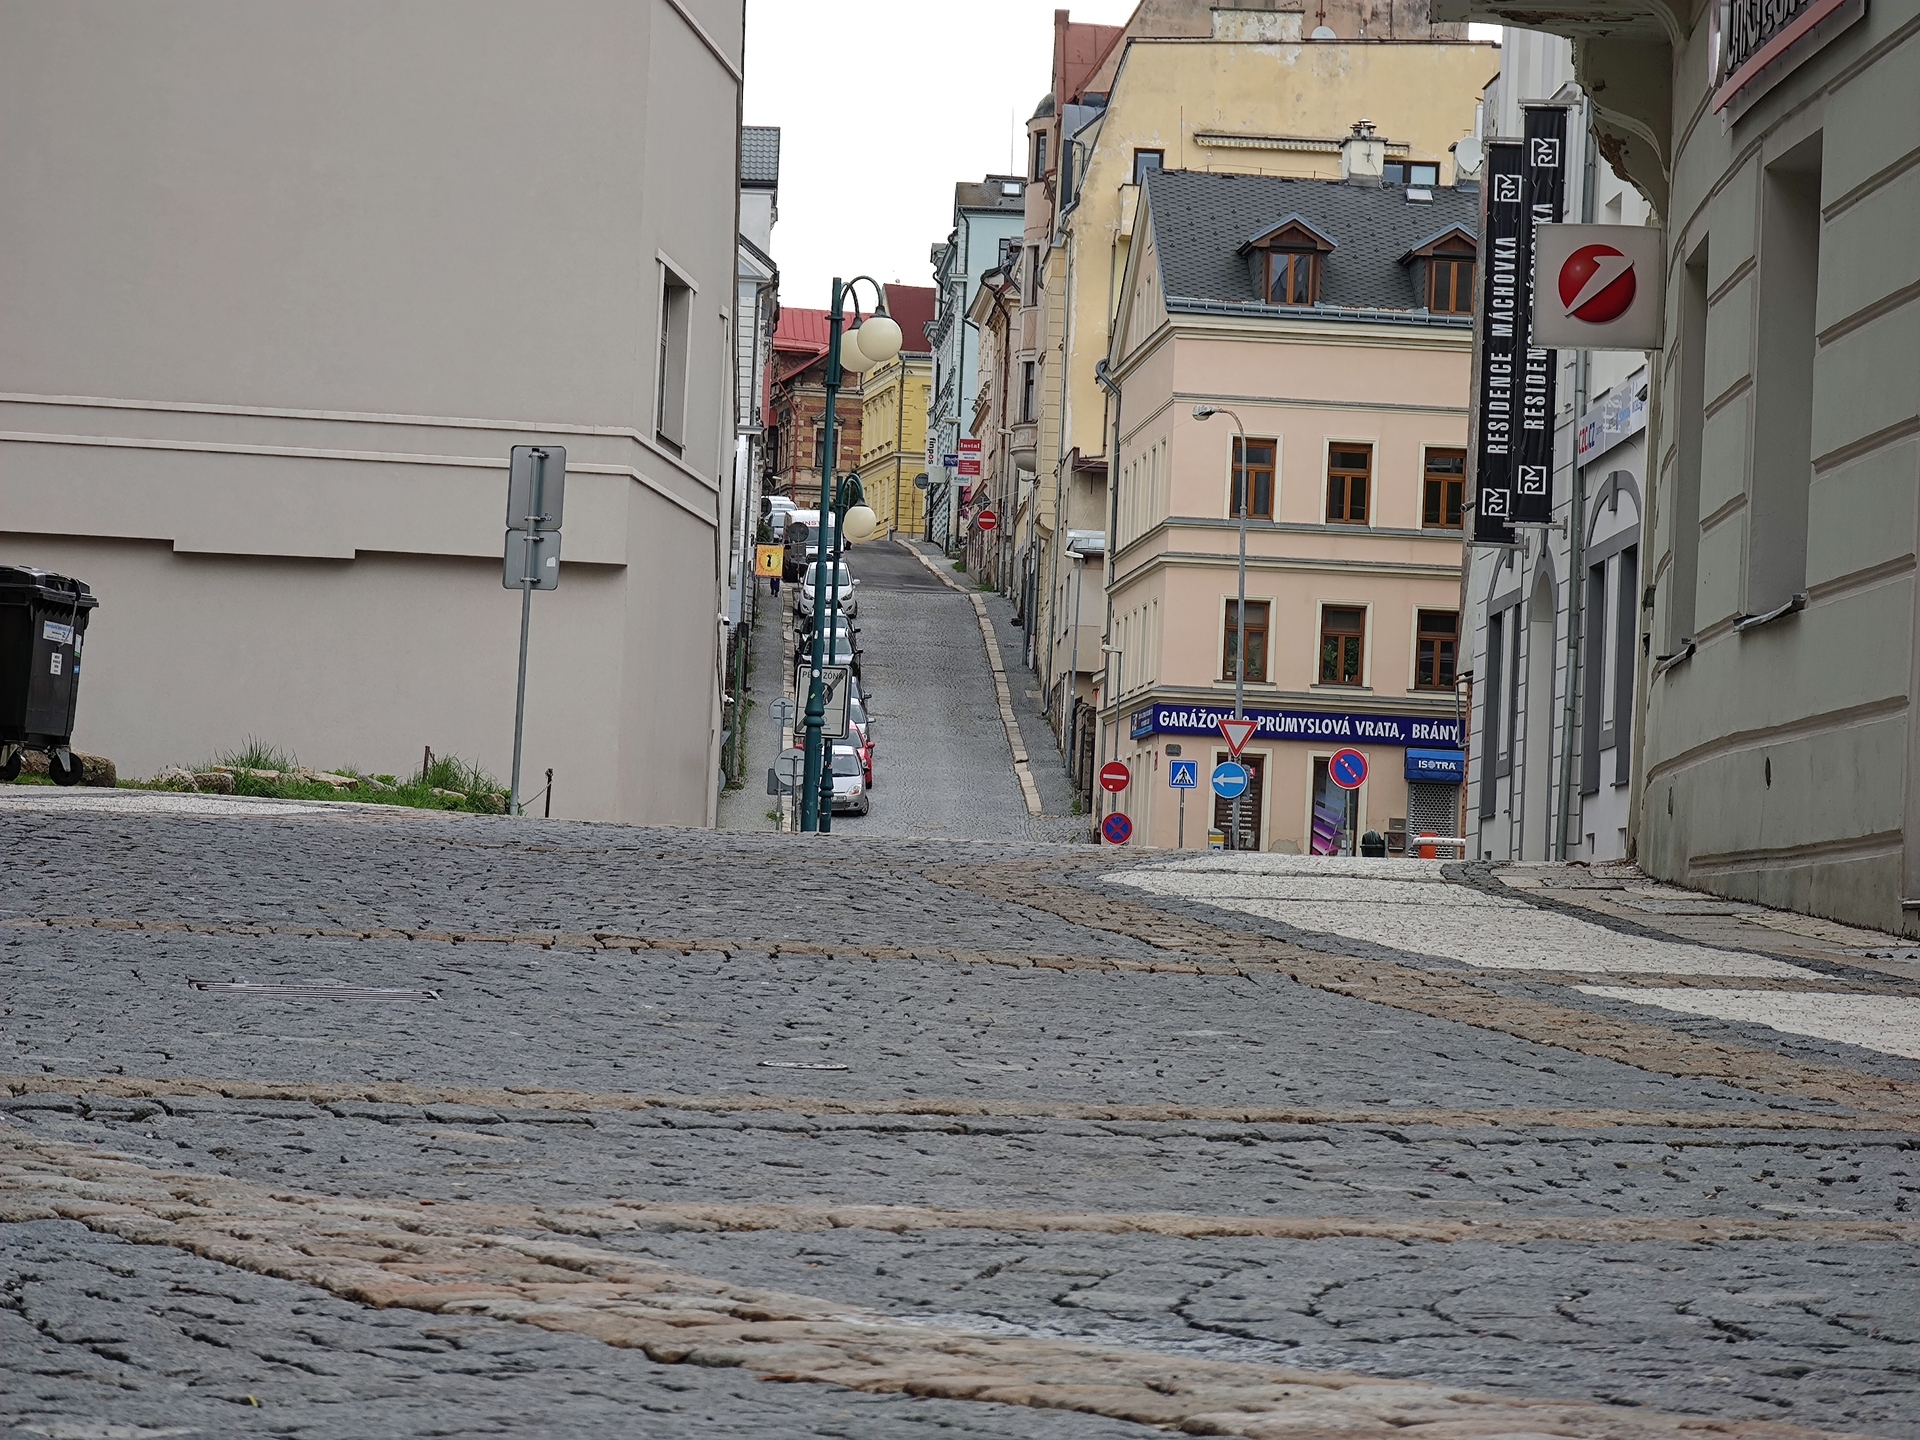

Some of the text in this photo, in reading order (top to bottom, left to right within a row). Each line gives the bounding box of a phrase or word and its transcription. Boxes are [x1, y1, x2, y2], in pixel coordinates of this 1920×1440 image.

[1487, 236, 1517, 455] RESIDENCE MÁCHOVKA
[1523, 324, 1548, 430] RESIDEN
[926, 437, 937, 465] finpos
[823, 670, 845, 680] ZÓNA
[1257, 712, 1351, 736] PRŮMYSLOVÁ
[1355, 720, 1406, 741] VRATA,
[1418, 760, 1457, 770] ISOTRA
